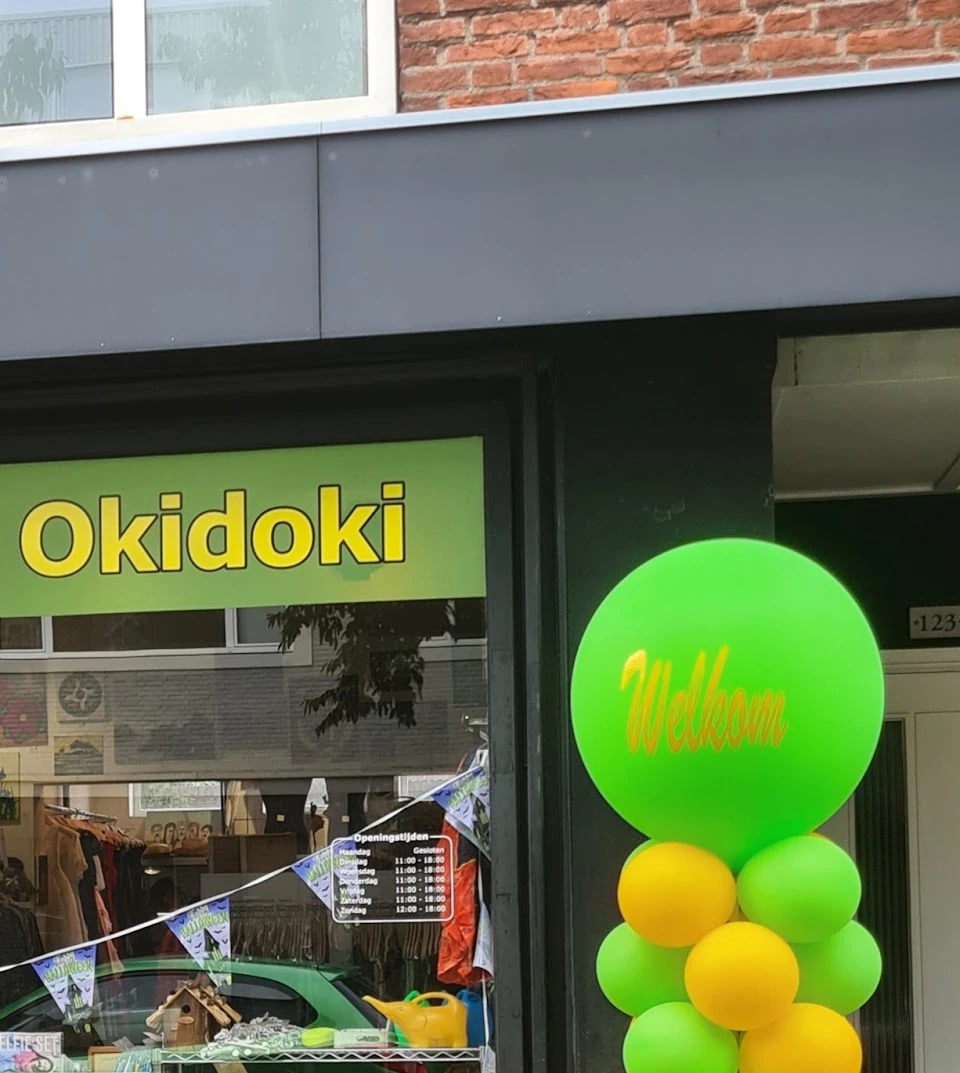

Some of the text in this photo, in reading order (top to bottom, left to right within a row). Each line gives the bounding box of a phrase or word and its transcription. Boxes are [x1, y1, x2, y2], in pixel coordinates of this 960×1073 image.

[19, 481, 406, 578] Okidoki
[619, 643, 789, 757] Welkom
[353, 832, 429, 844] Openingstijden
[413, 846, 445, 854] Gesloten
[423, 856, 445, 864] 18:00
[395, 866, 416, 874] 11:00
[395, 876, 416, 884] 11:00
[424, 885, 445, 893] 18:00
[424, 895, 446, 903] 18:00
[340, 905, 367, 915] Zondag
[396, 905, 417, 913] 12:00
[36, 1034, 59, 1053] SET
